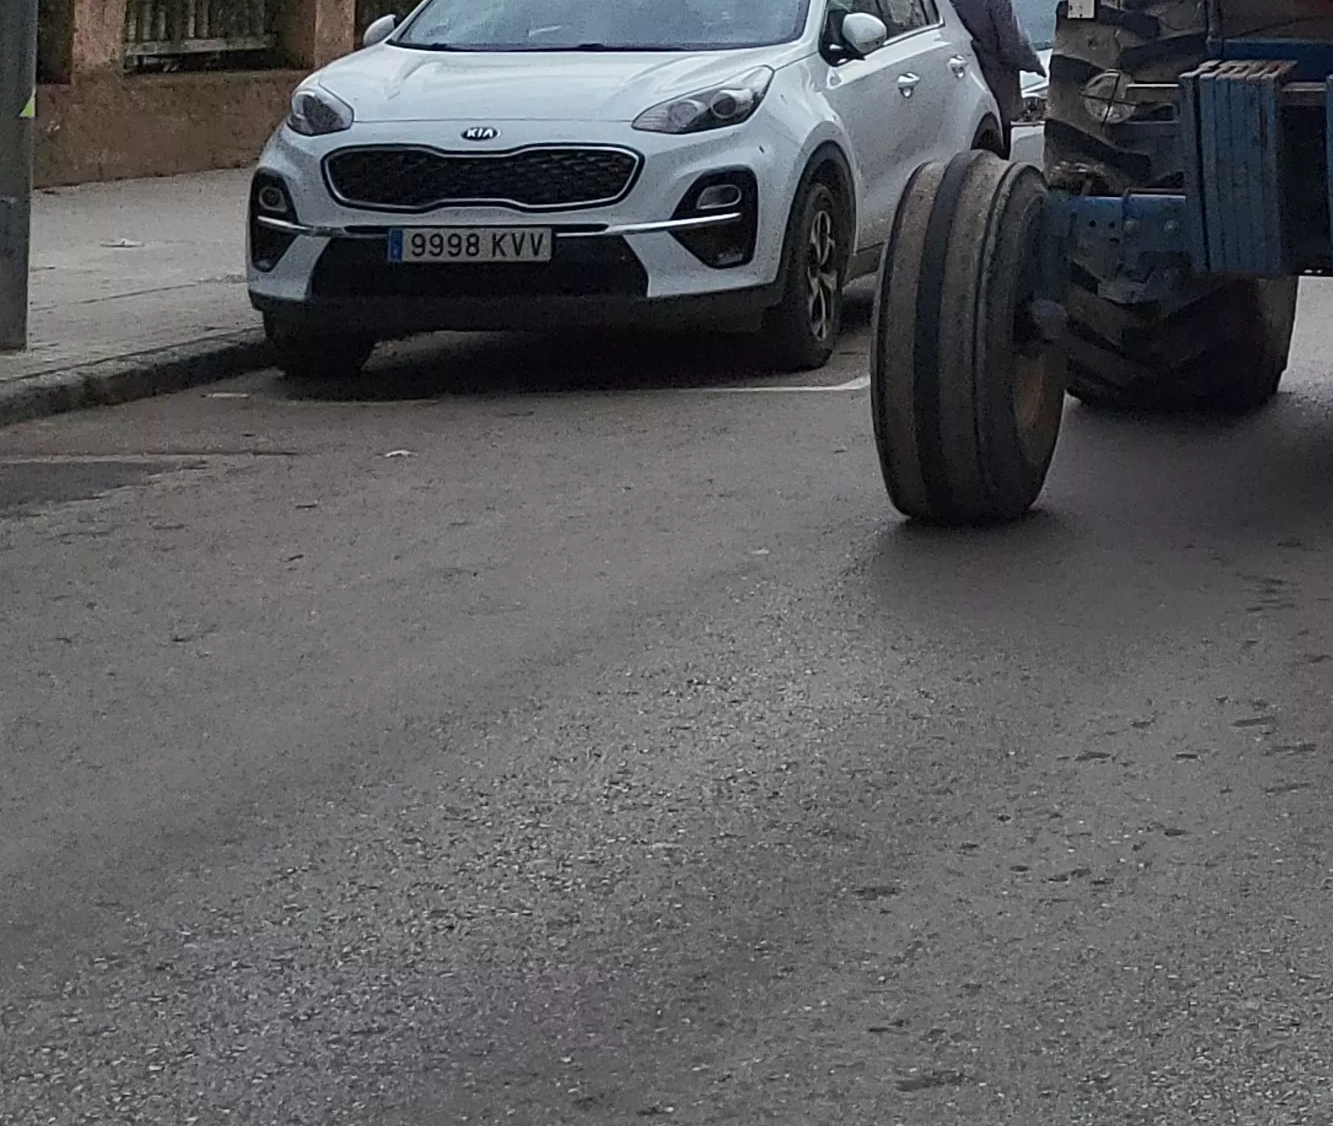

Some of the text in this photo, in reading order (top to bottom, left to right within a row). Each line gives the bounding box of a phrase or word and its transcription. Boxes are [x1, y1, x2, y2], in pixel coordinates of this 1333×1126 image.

[466, 128, 495, 138] KIA
[411, 233, 545, 257] 9998 KVV
